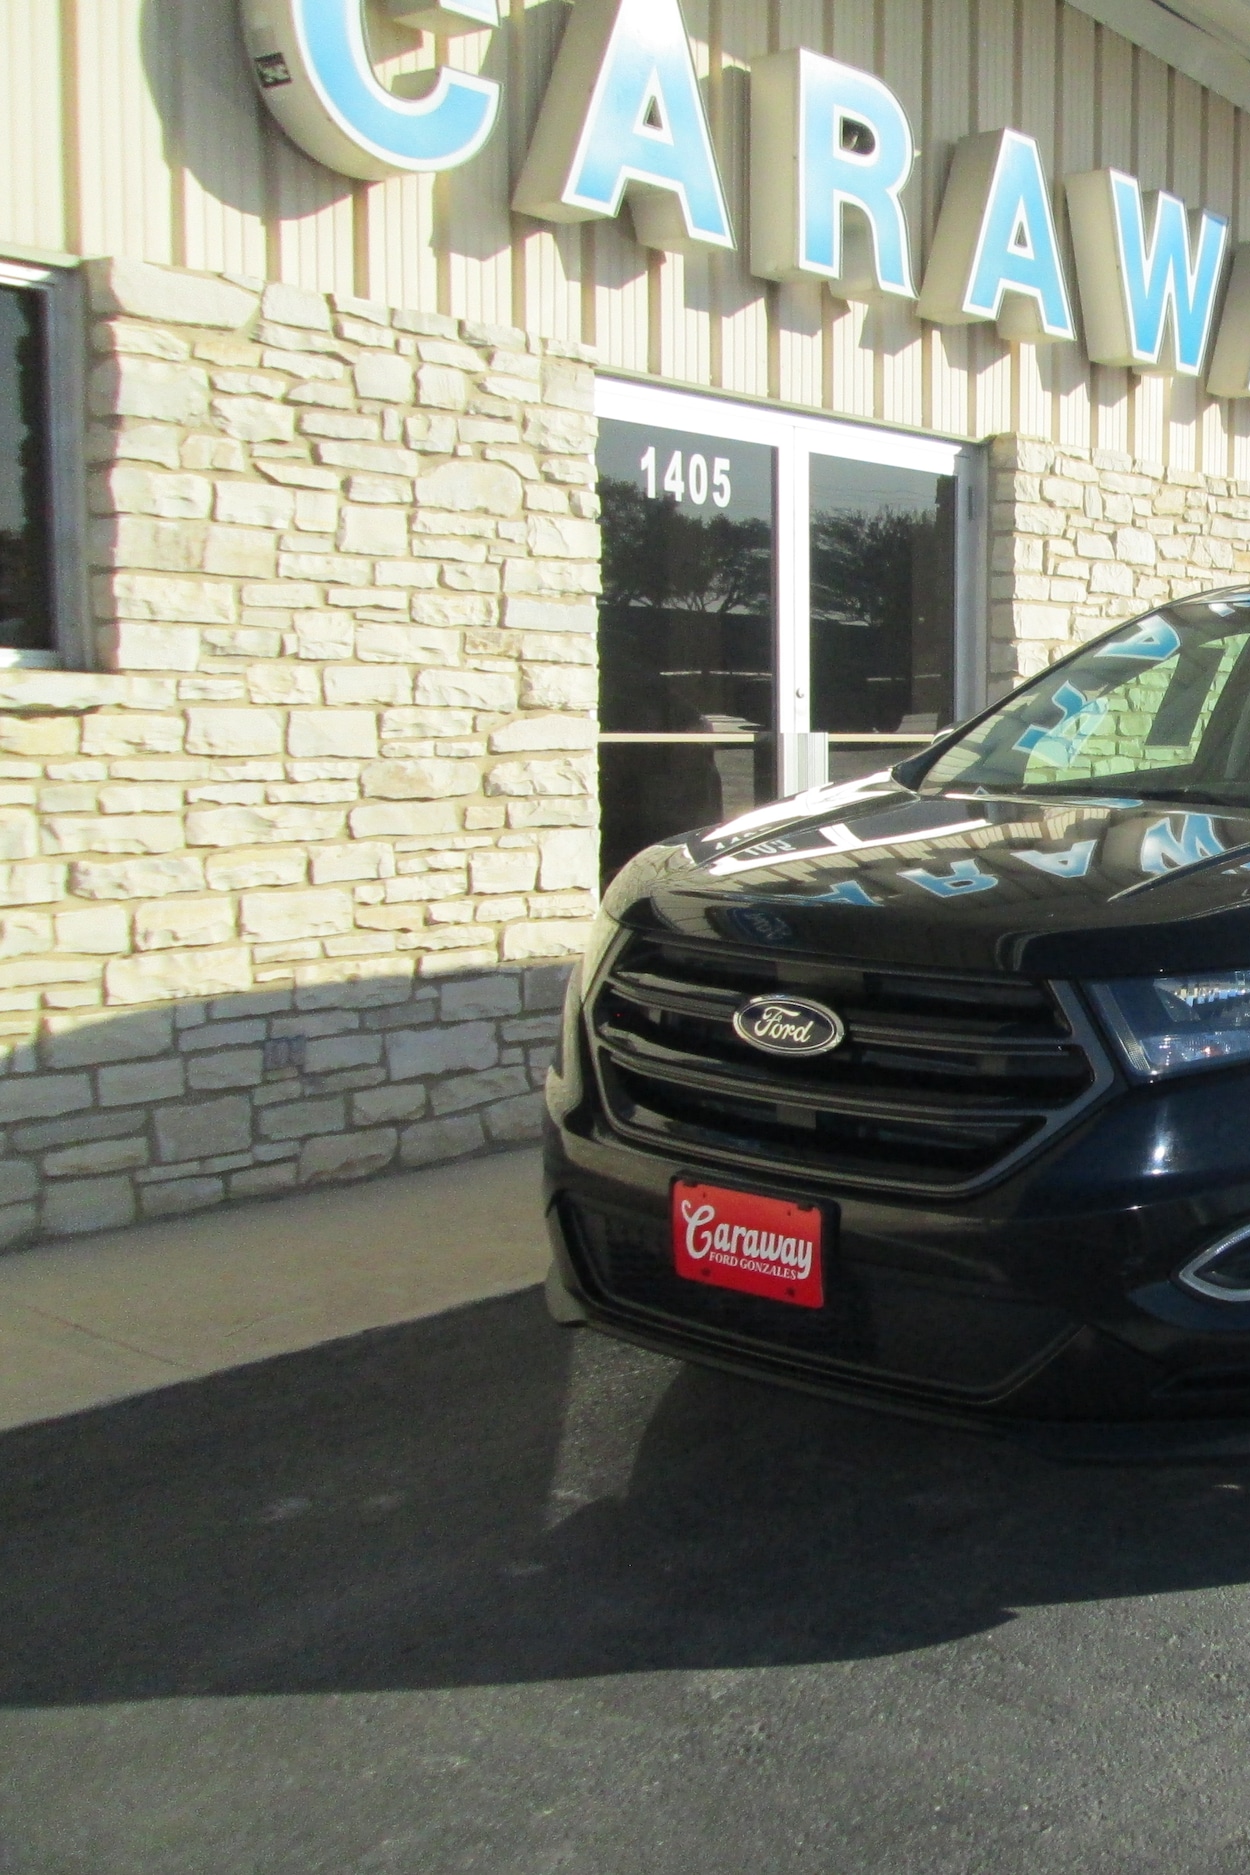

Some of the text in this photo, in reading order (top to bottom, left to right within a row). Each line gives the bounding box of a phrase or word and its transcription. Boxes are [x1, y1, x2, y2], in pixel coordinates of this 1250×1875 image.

[640, 446, 732, 508] 1405
[754, 1006, 815, 1043] Ford
[681, 1199, 813, 1280] Caraway
[708, 1251, 797, 1280] FORD GONZALES
